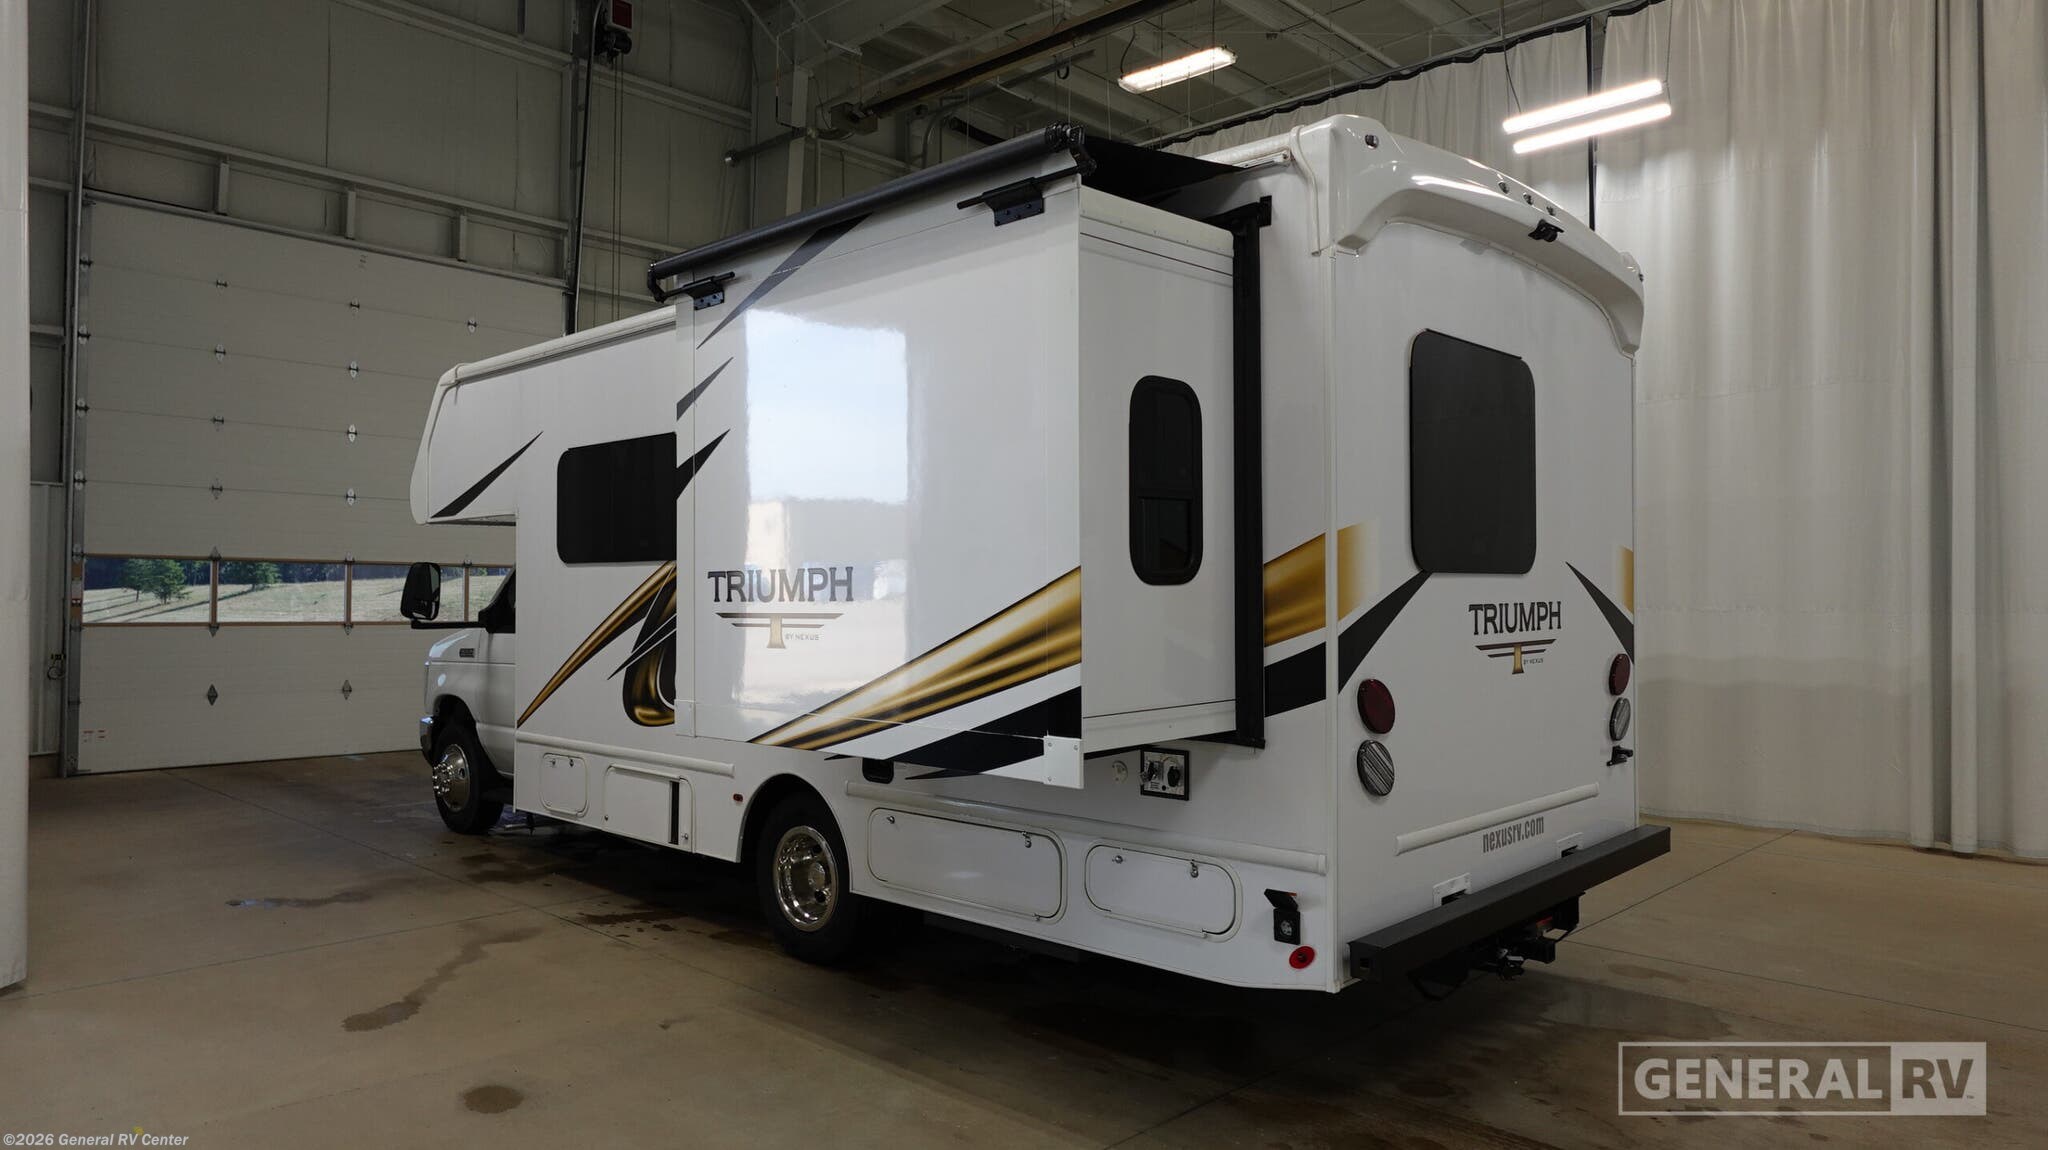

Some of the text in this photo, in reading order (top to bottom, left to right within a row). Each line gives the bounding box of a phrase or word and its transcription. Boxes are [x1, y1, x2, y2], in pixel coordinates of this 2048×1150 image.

[707, 566, 855, 603] TRIUMPH
[1468, 601, 1562, 635] TRIUMPH
[1482, 816, 1545, 853] nexusrv.com
